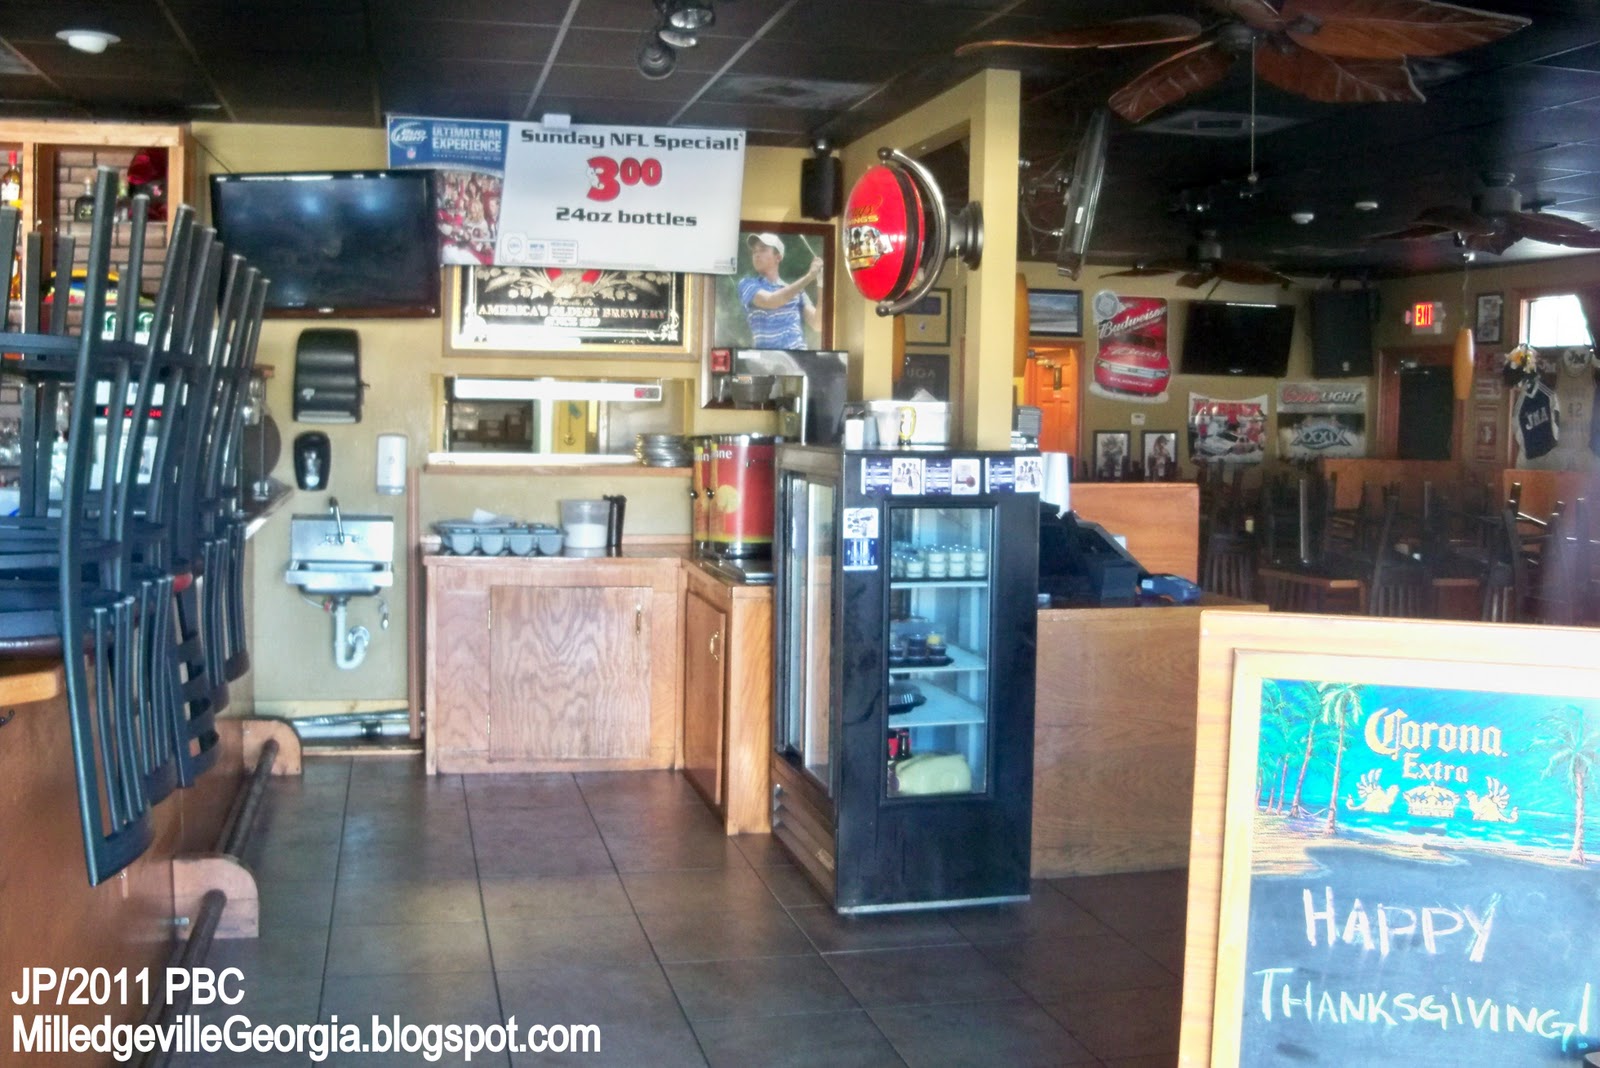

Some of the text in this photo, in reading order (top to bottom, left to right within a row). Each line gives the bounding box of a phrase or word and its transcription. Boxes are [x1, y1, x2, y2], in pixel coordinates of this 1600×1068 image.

[432, 125, 502, 141] ULTIMATE FAN
[521, 129, 740, 151] Sunday NFL Special!
[432, 138, 502, 153] EXPERIENCE
[555, 206, 698, 227] 24oz bottles
[550, 305, 600, 319] OLDEST
[602, 307, 667, 320] BREWERY
[1099, 305, 1168, 340] Budweiser
[1415, 304, 1433, 326] EXIT
[1321, 390, 1362, 404] LIGHT
[1289, 426, 1352, 447] XXXIX
[1402, 752, 1469, 784] Extra
[1302, 885, 1502, 963] HAPPY
